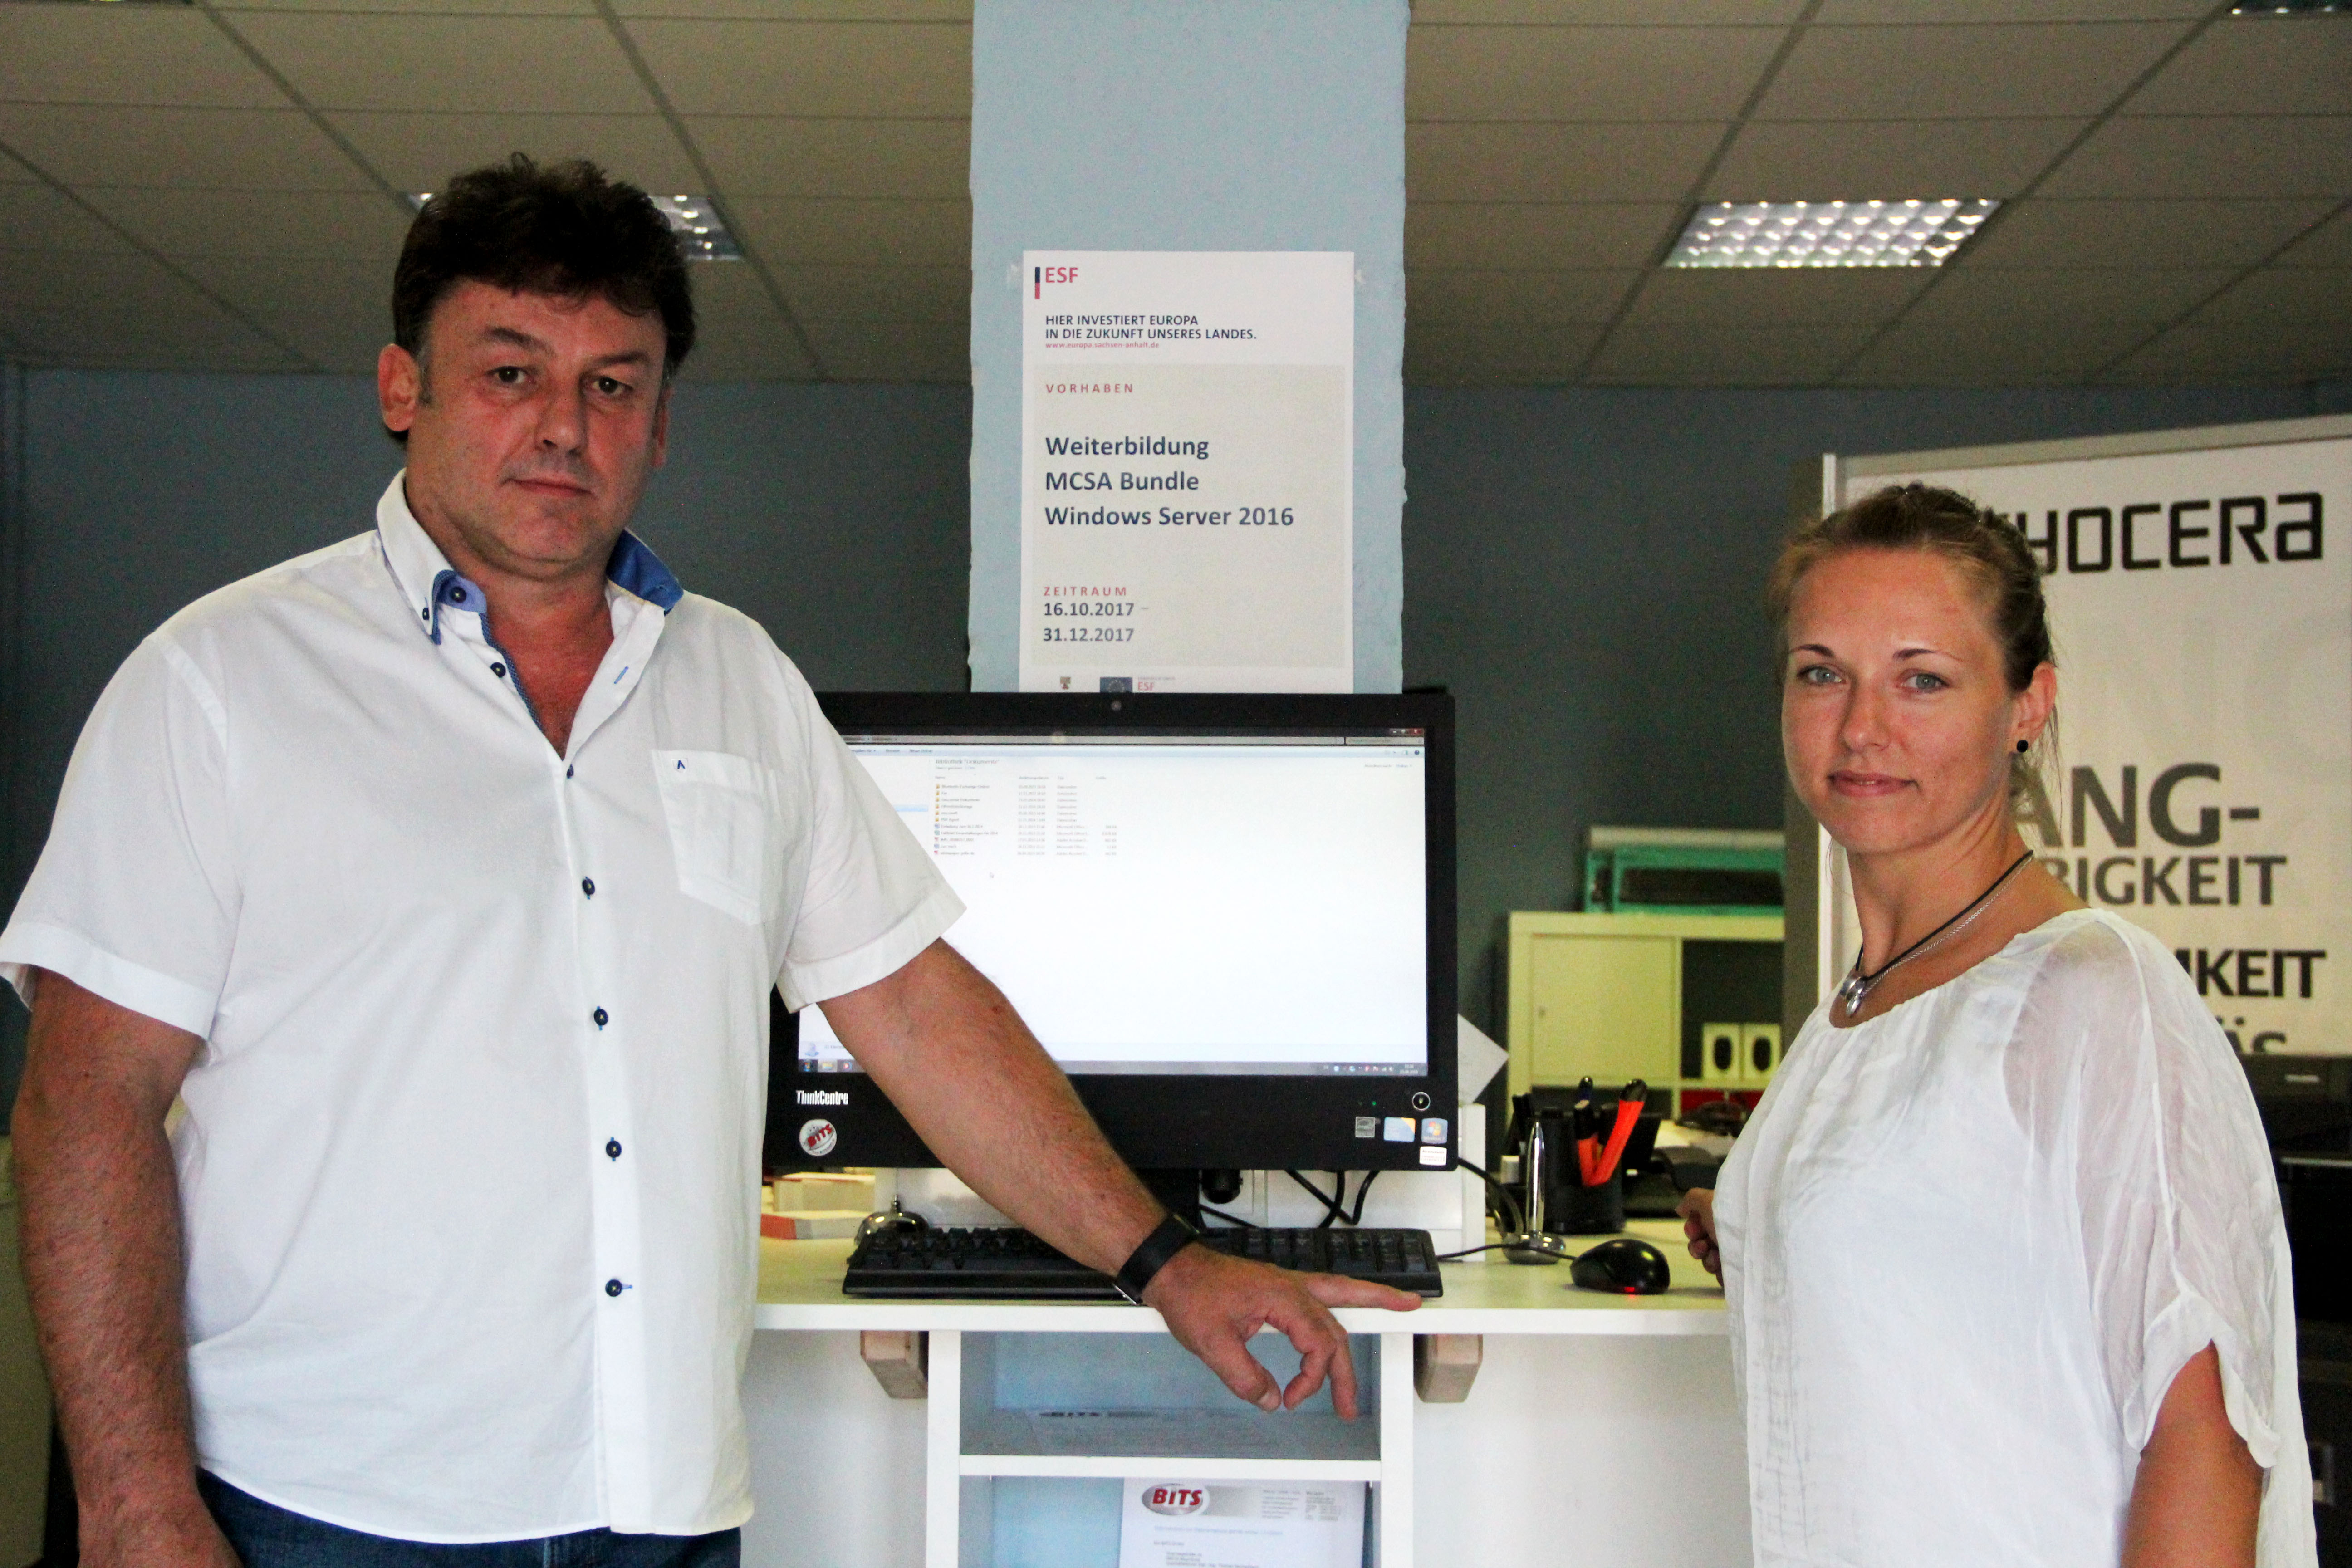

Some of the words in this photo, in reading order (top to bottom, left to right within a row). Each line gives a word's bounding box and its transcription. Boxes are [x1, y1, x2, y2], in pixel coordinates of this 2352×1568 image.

[1045, 267, 1078, 284] ESF
[1046, 315, 1073, 325] HIER
[1078, 315, 1146, 325] INVESTIERT
[1150, 315, 1198, 326] EUROPA
[1046, 329, 1058, 339] IN
[1063, 329, 1082, 339] DIE
[1086, 329, 1143, 339] ZUKUNFT
[1147, 329, 1201, 339] UNSERES
[1205, 329, 1257, 339] LANDES.
[1045, 341, 1160, 350] www.europa.sachsen-anhalt.de
[1046, 383, 1133, 394] VORHABEN
[1045, 436, 1209, 460] Weiterbildung
[1046, 472, 1112, 490] MCSA
[1120, 471, 1199, 490] Bundle
[1044, 506, 1152, 525] Windows
[1159, 507, 1231, 526] Server
[1239, 507, 1294, 526] 2016
[1997, 492, 2323, 575] YOCERA
[1044, 587, 1127, 597] ZEITRAUM
[1044, 603, 1134, 616] 16.10.2017
[1043, 628, 1134, 642] 31.12.2017
[2011, 763, 2261, 849] ANG-
[796, 1090, 849, 1105] ThinkCentre
